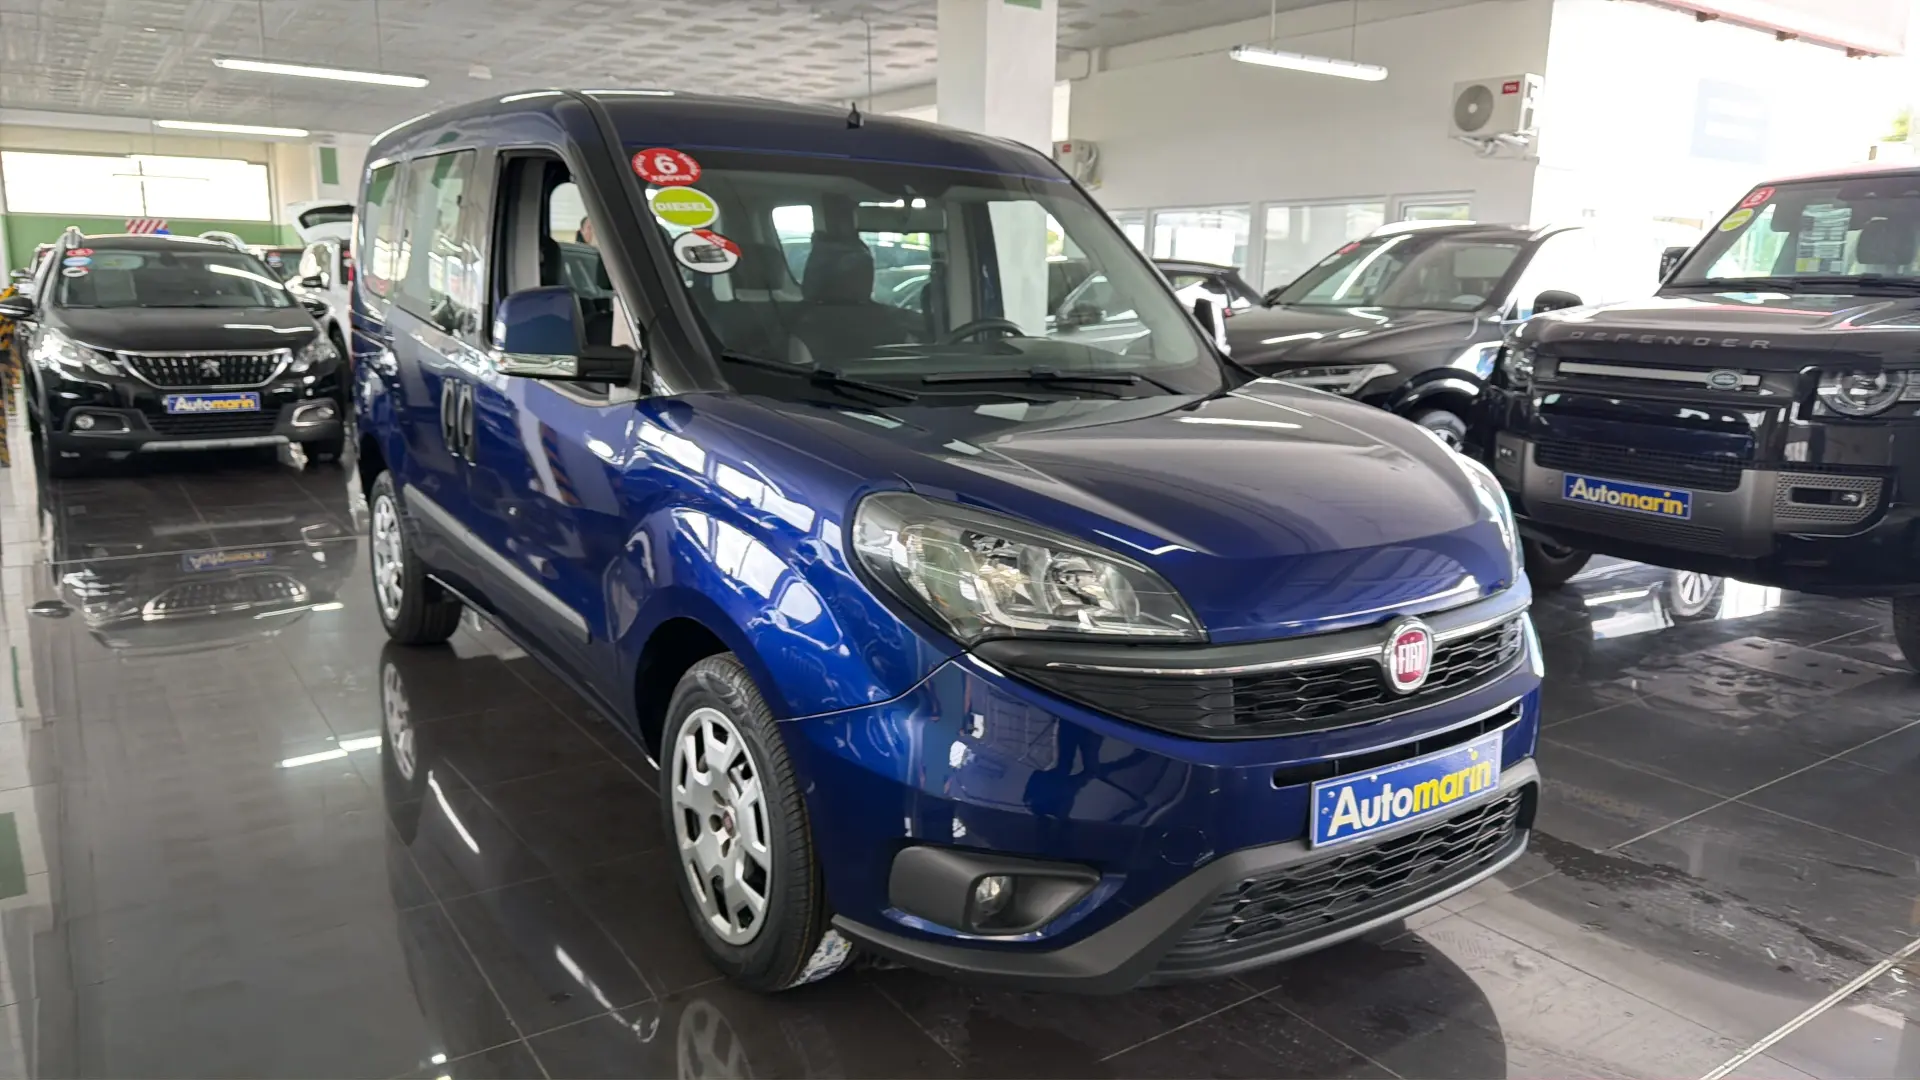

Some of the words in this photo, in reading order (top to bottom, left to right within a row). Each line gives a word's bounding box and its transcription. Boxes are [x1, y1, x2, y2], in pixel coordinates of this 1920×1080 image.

[654, 153, 678, 175] 6
[655, 202, 713, 212] DIESEL
[1569, 331, 1771, 349] DEFENDER
[175, 393, 255, 412] Automarin
[1569, 477, 1684, 515] Automarin
[1397, 640, 1426, 675] FIAT
[1327, 750, 1493, 837] Automarin
